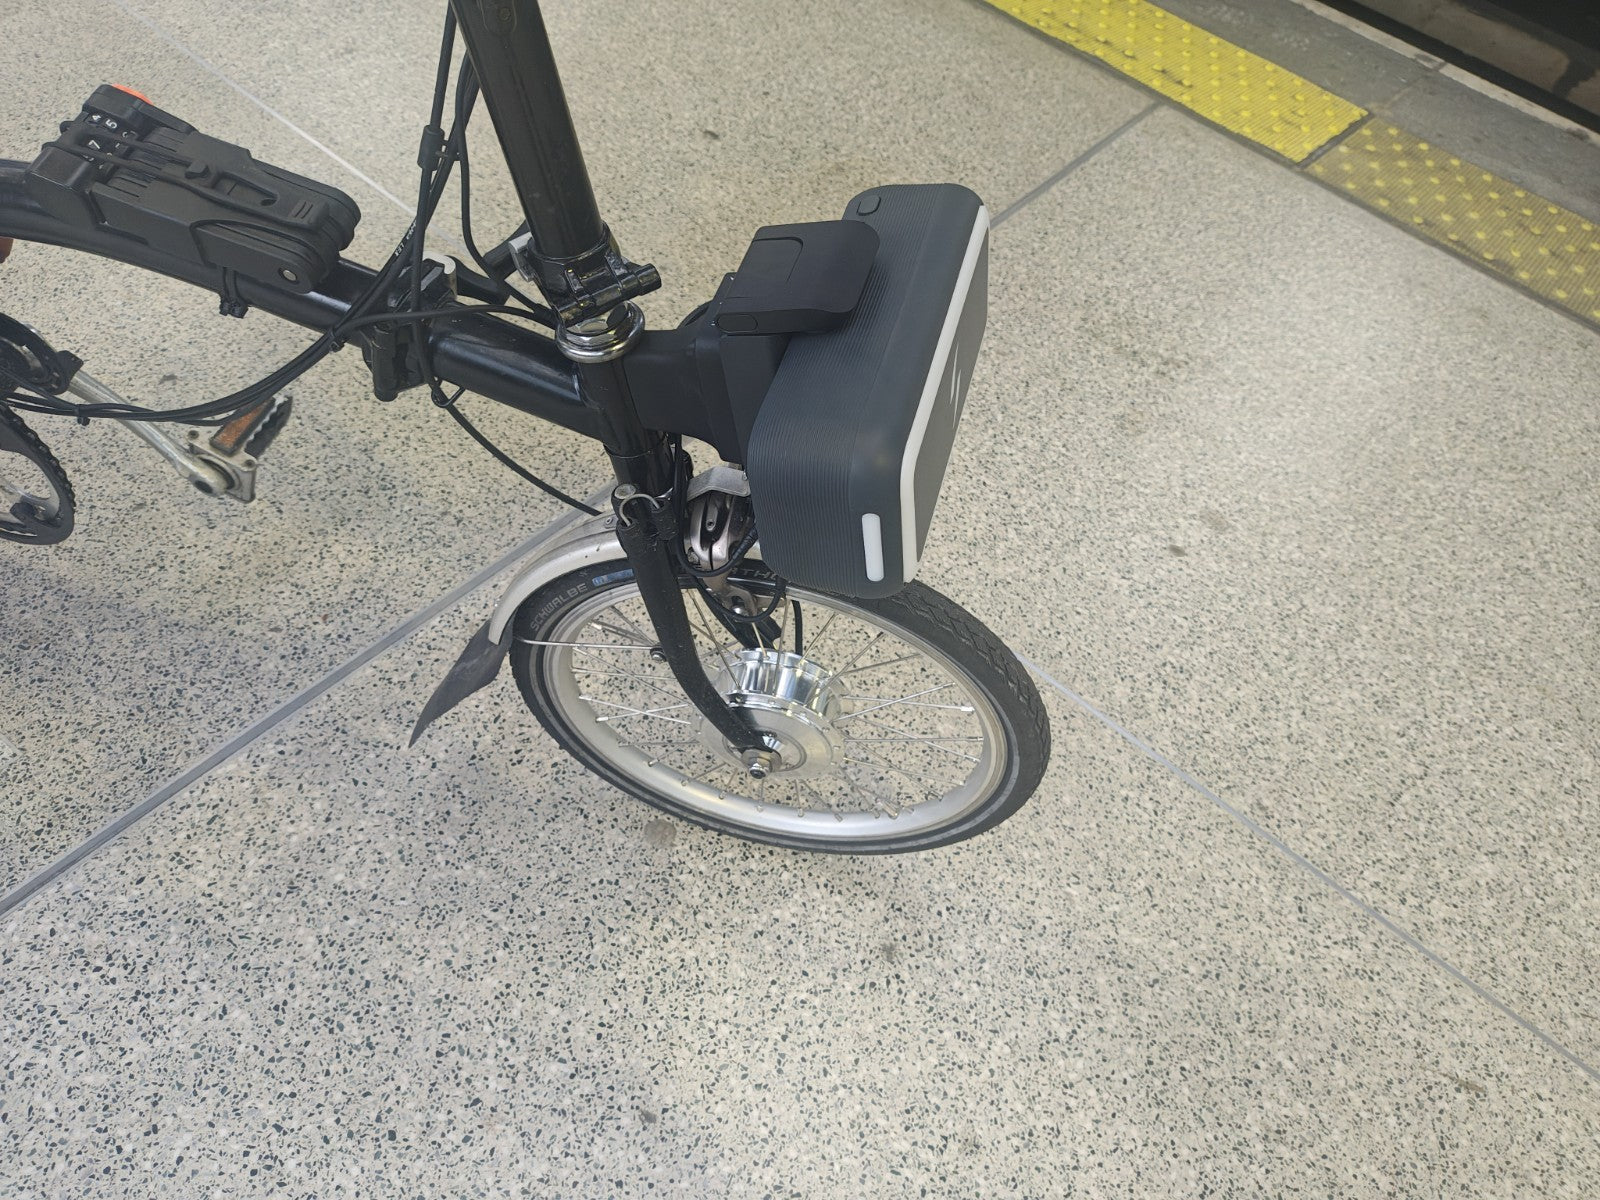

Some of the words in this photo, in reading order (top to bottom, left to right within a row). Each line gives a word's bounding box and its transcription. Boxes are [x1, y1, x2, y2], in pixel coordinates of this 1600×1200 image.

[105, 119, 118, 129] 5
[88, 139, 101, 150] 7
[530, 582, 588, 631] SCHWALBE
